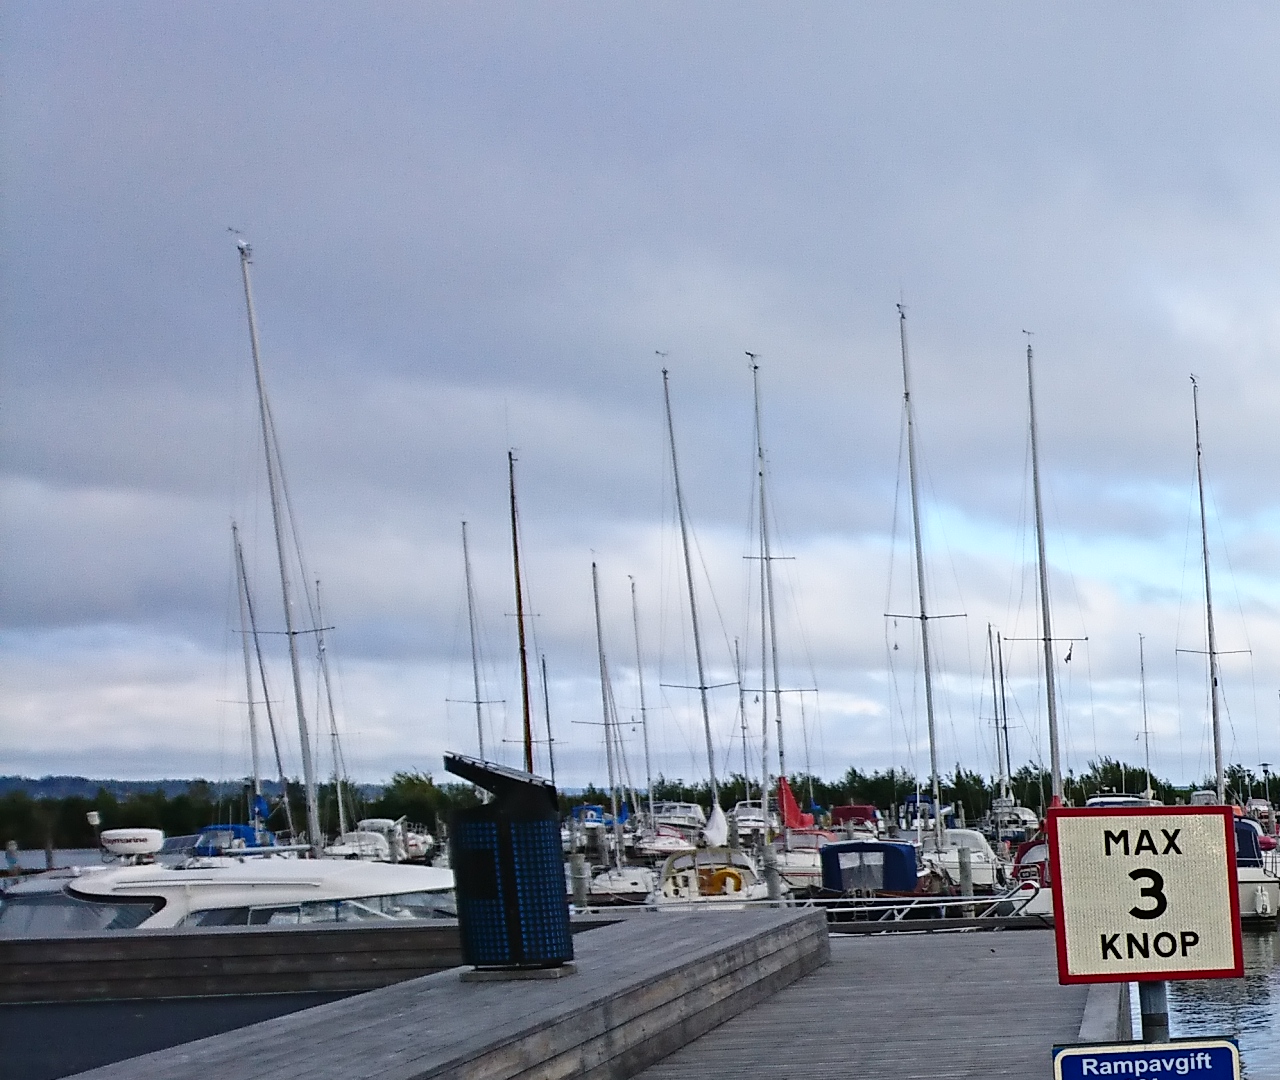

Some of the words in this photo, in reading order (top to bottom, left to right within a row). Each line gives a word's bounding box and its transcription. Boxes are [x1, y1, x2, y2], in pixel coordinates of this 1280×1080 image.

[1104, 829, 1183, 856] MAX
[1127, 868, 1168, 920] 3
[1100, 931, 1200, 961] KNOP
[1081, 1052, 1213, 1077] Rampavgift
